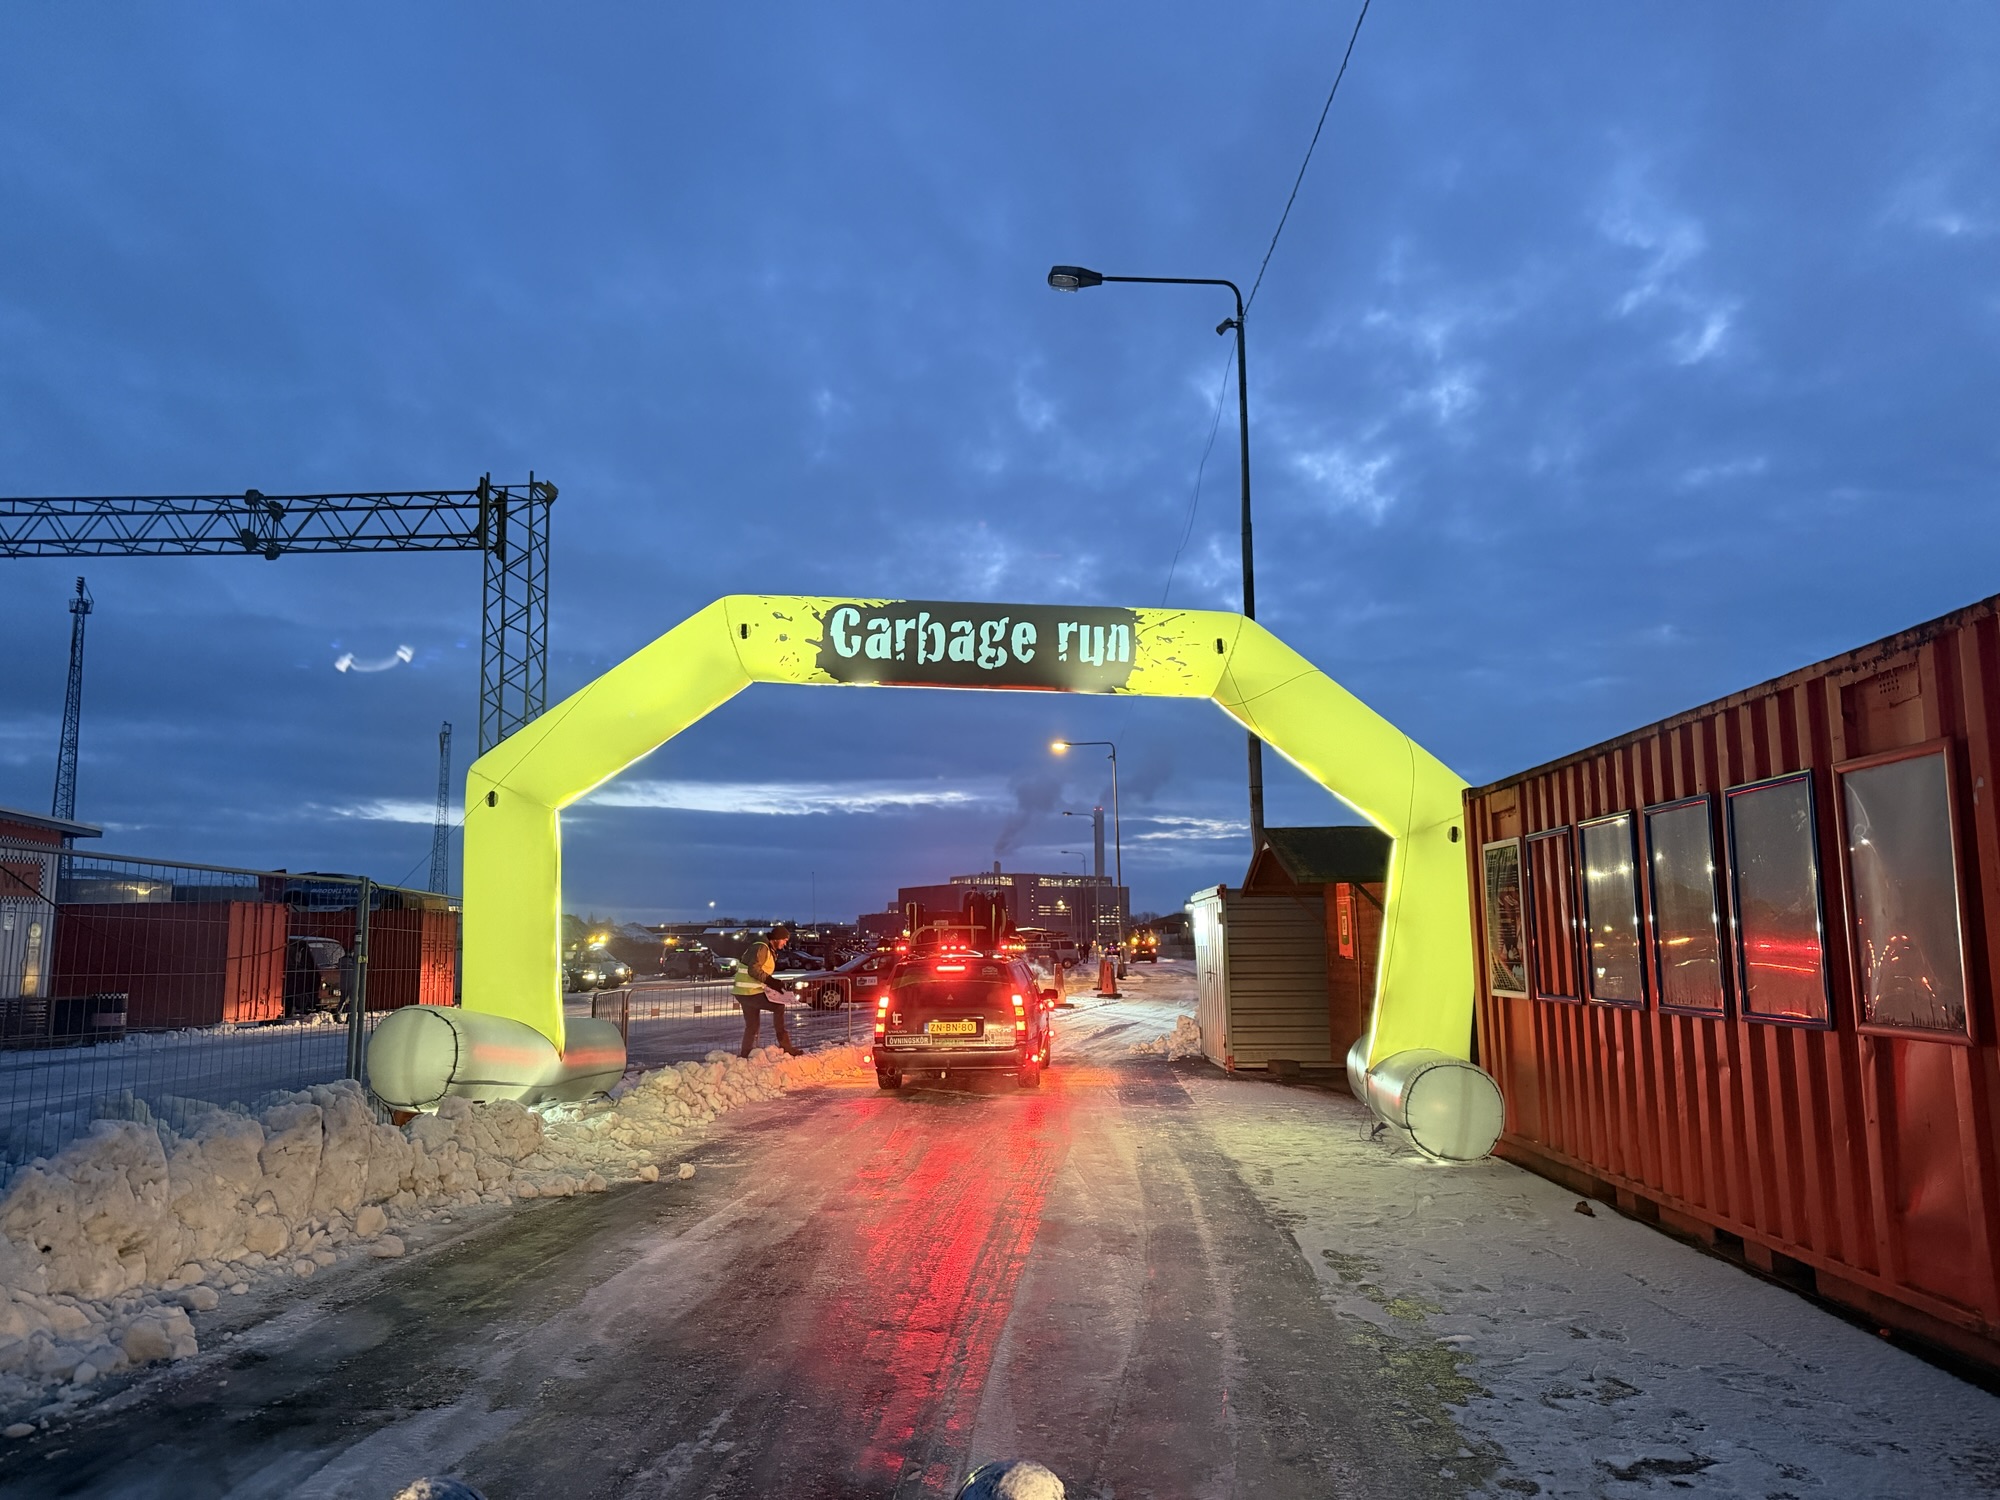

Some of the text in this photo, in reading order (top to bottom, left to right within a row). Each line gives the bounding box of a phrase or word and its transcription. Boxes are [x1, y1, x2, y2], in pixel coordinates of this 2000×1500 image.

[830, 607, 1130, 670] Carbage run
[3, 871, 34, 890] WC
[889, 1036, 929, 1045] ÖVNINGSKÖR
